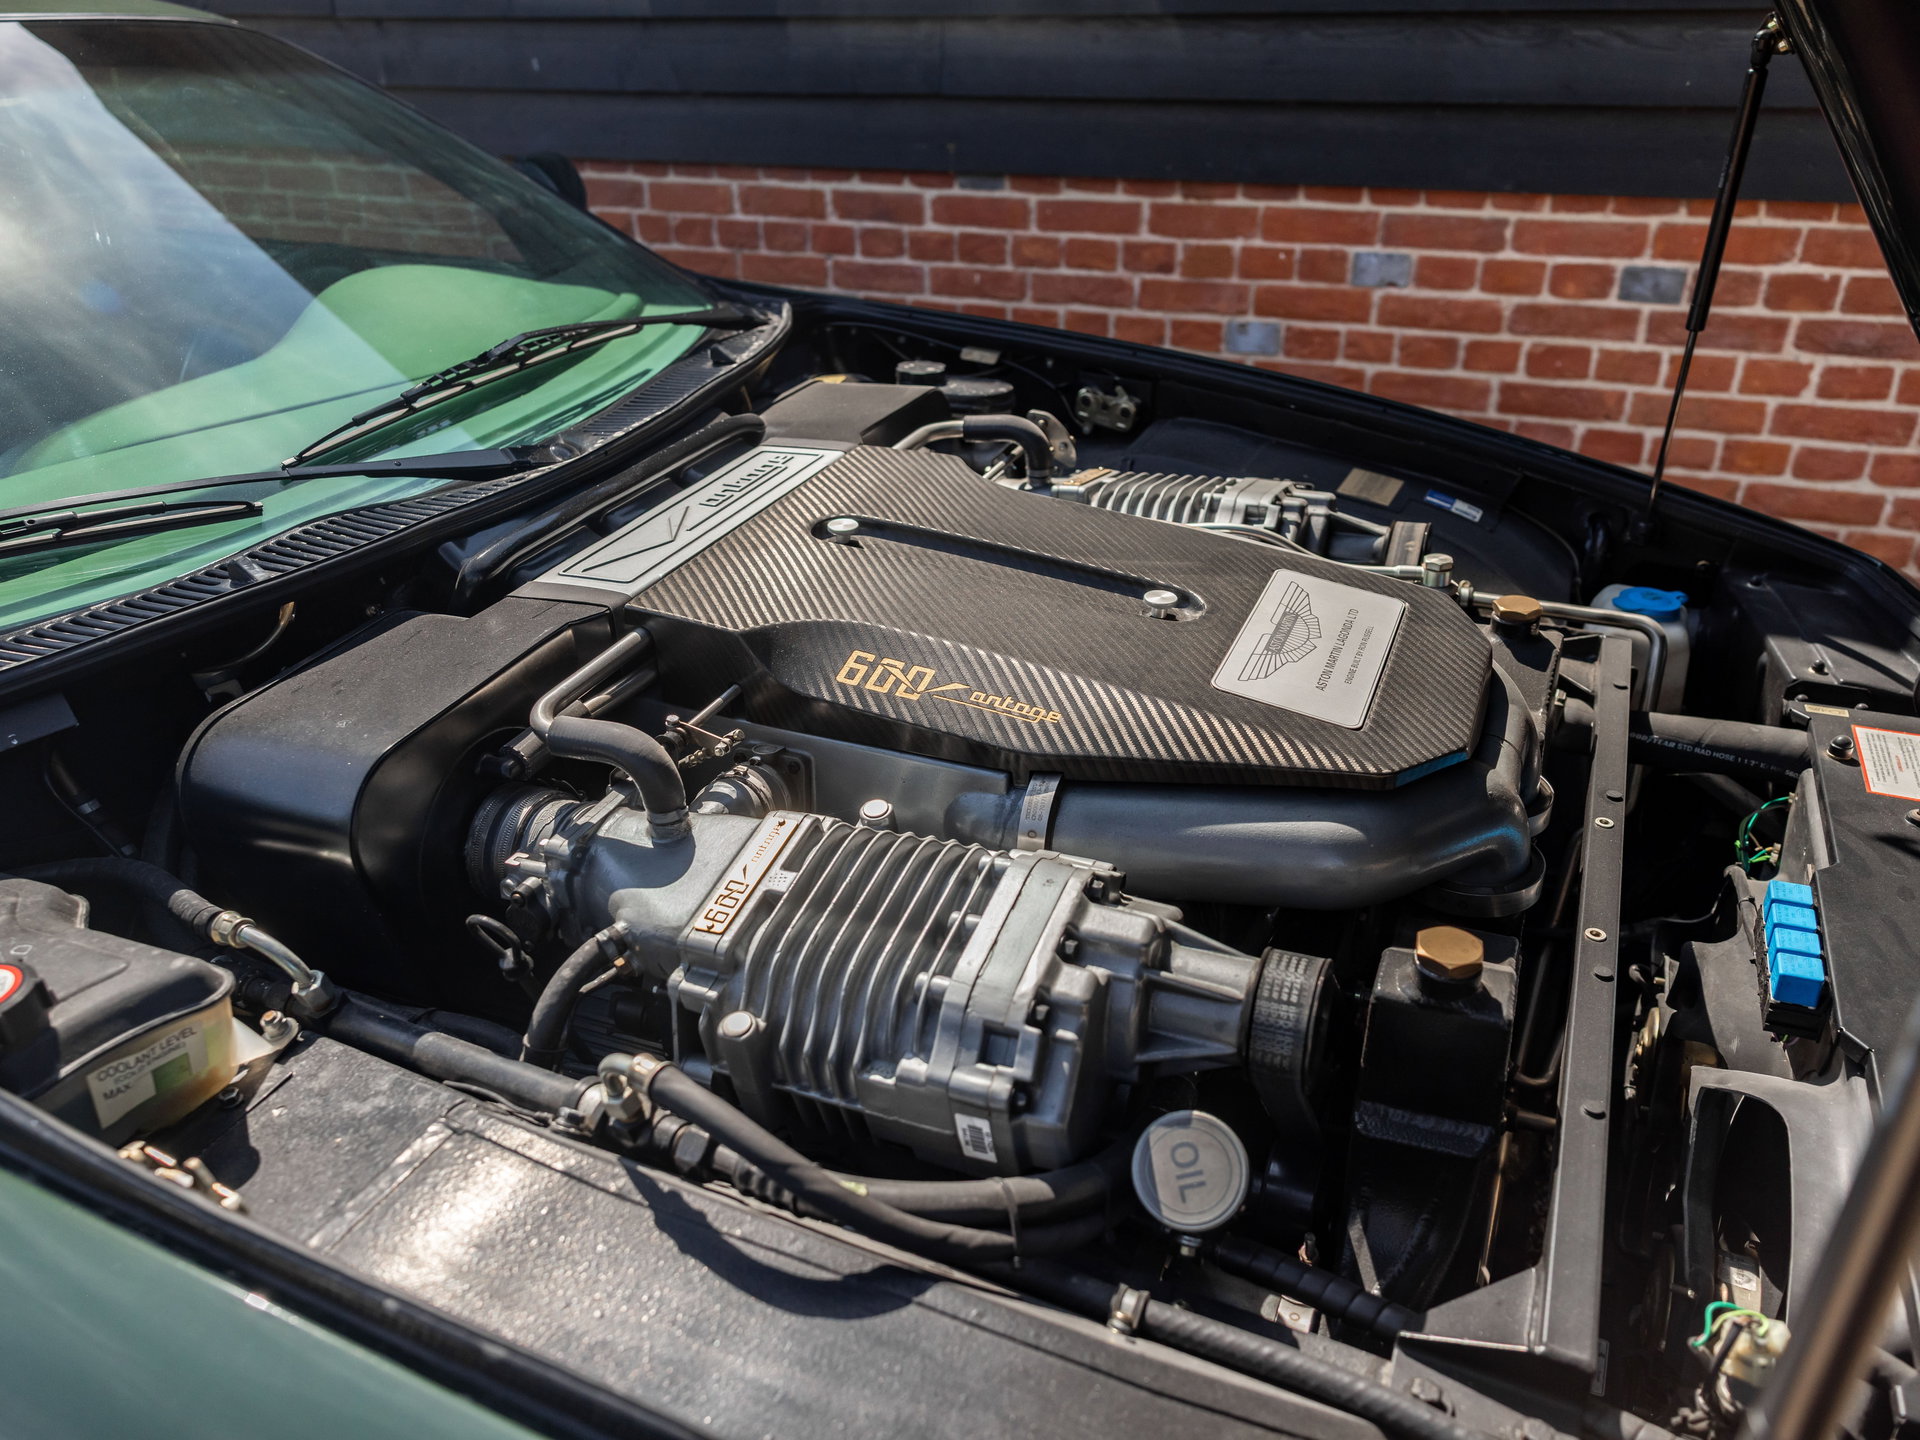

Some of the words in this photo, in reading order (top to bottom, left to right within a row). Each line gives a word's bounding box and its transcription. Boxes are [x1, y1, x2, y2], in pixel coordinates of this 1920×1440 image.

[1315, 667, 1333, 691] ASTON
[1325, 645, 1343, 670] MARTIN
[1336, 618, 1355, 647] LAGONDA
[1347, 608, 1359, 620] LTD
[1350, 656, 1361, 669] BUILT
[835, 650, 936, 701] 600
[1344, 666, 1357, 685] ENGINE
[1677, 743, 1693, 752] STD
[1712, 751, 1735, 762] HOSE
[96, 1046, 157, 1081] COOLANT
[159, 1026, 197, 1052] LEVEL
[103, 1082, 132, 1101] MAX
[1170, 1141, 1206, 1204] OIL
